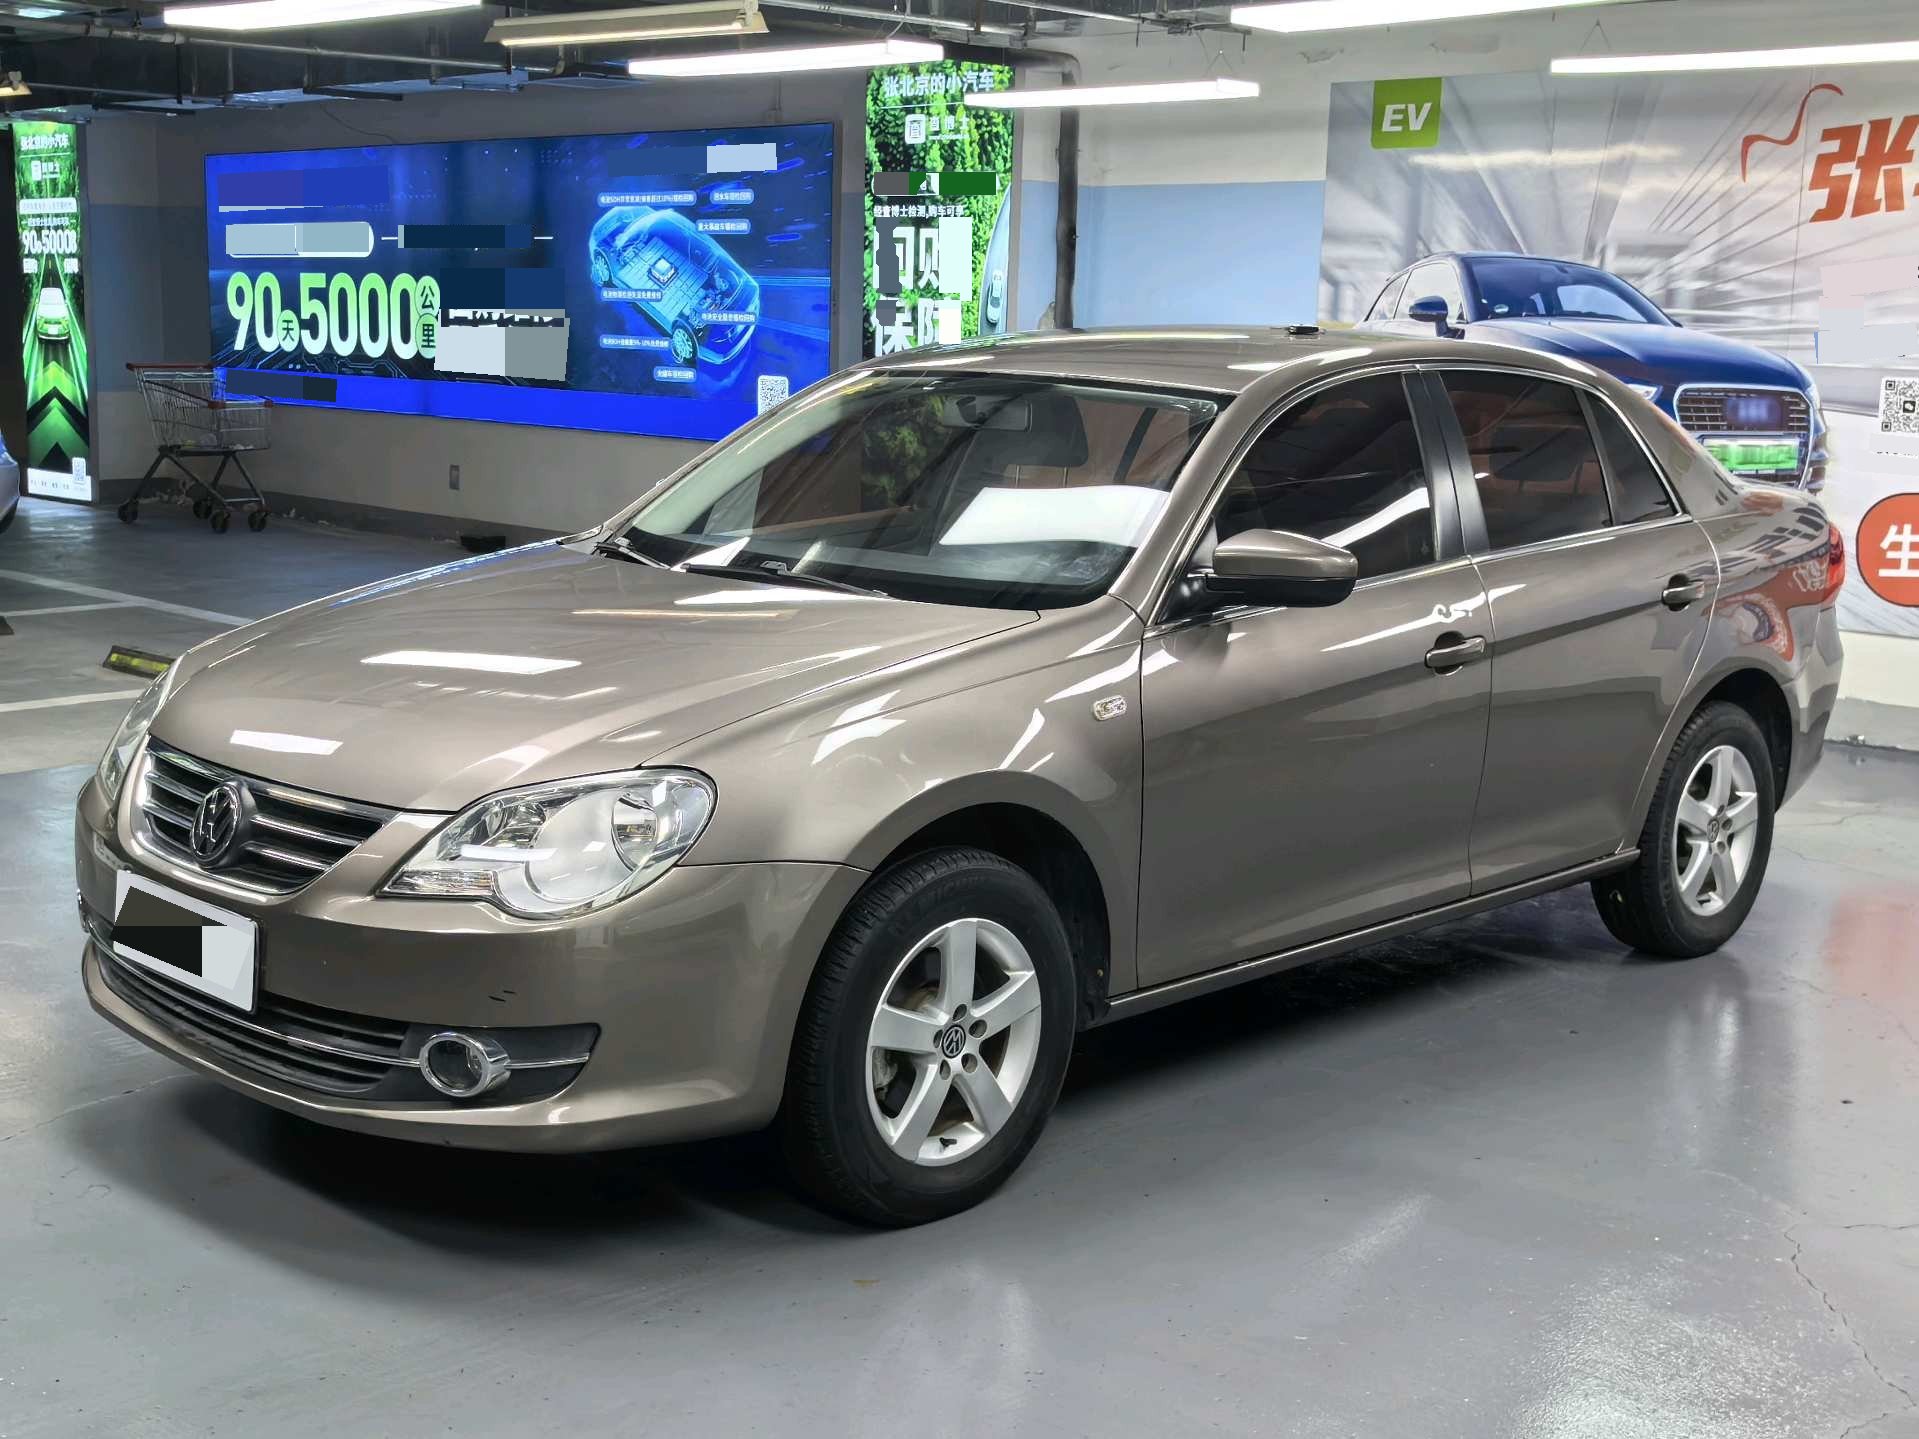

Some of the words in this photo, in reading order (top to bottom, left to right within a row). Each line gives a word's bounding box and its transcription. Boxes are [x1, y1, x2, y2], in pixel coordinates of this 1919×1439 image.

[884, 69, 994, 98] 张北京的小汽车
[1381, 102, 1432, 132] EV
[1808, 114, 1919, 223] 张
